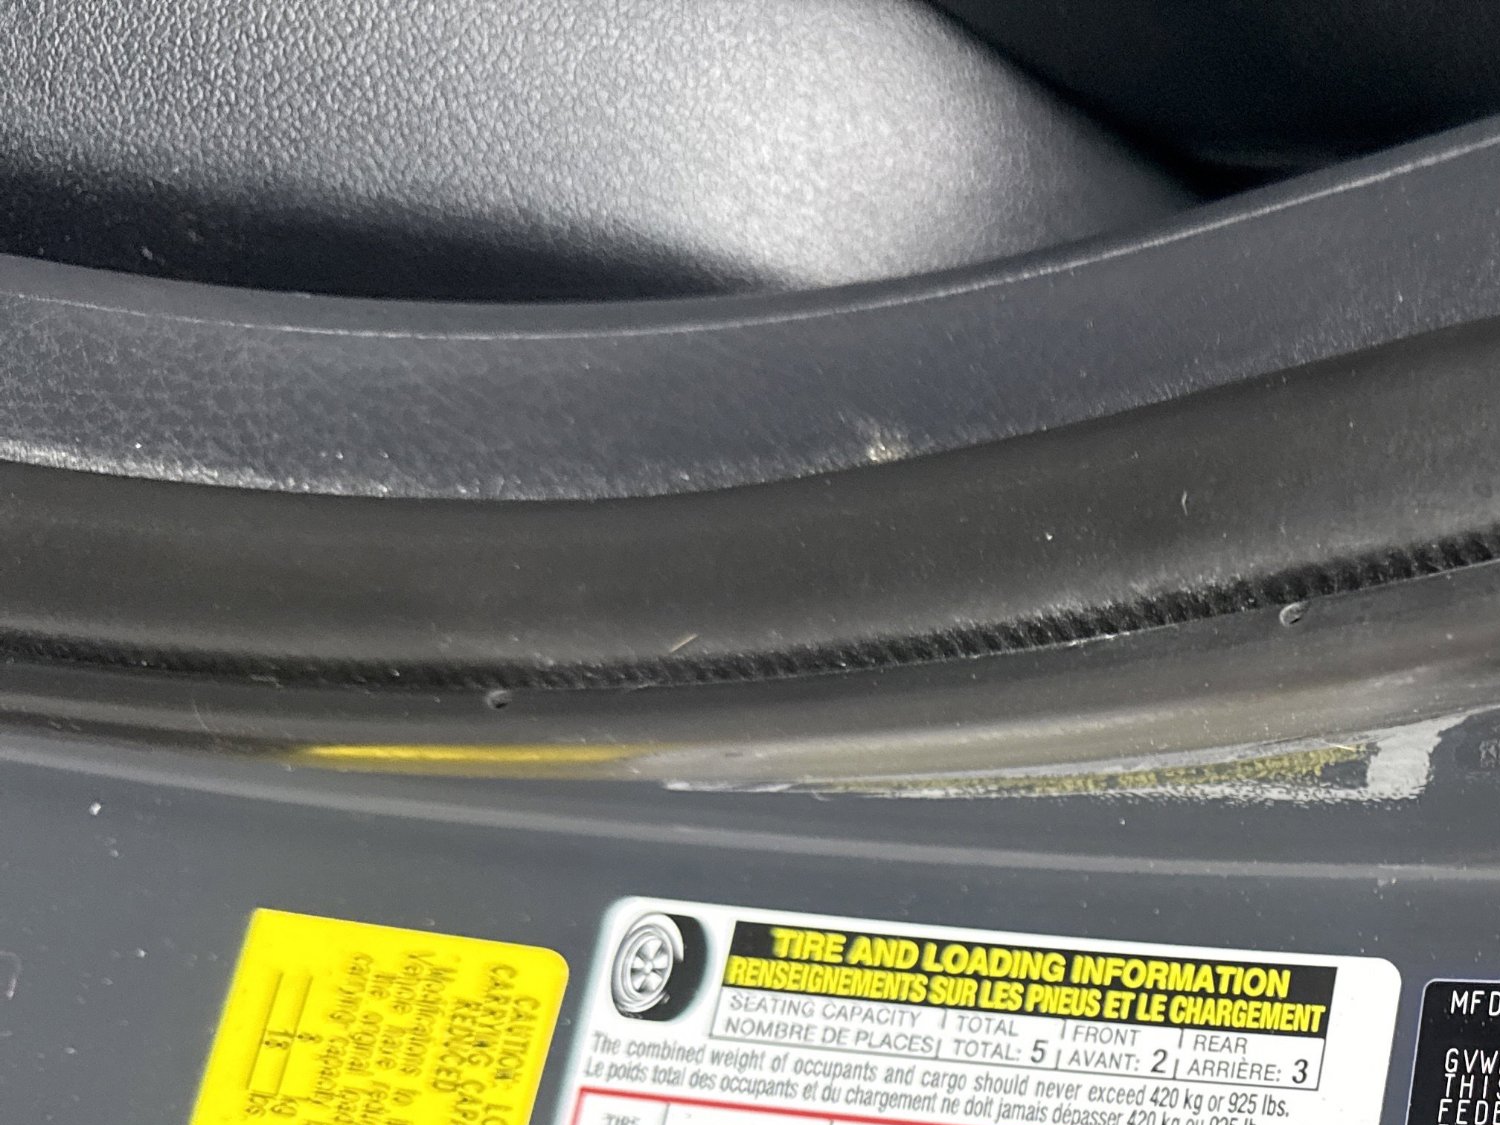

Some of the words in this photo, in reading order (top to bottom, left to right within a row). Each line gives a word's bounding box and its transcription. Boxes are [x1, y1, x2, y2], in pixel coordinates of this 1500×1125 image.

[771, 927, 846, 963] TIRE
[846, 935, 919, 969] AND
[921, 942, 1066, 982] LOADING
[1071, 955, 1290, 998] INFORMATION
[725, 955, 928, 1002] RENSEIGNEMENTS
[927, 975, 978, 1007] SUR
[978, 979, 1025, 1011] LES
[1024, 983, 1102, 1017] PNEUS
[1102, 989, 1136, 1020] ET
[1135, 992, 1168, 1022] LE
[1169, 995, 1326, 1032] CHARGEMENT
[729, 991, 815, 1018] SEATING
[821, 1002, 921, 1027] CAPACITY
[464, 963, 518, 1069] CARRYING
[957, 1014, 1019, 1037] TOTAL
[429, 998, 482, 1095] REDUCED
[724, 1017, 816, 1042] NOMBRE
[820, 1025, 850, 1045] DE
[854, 1029, 934, 1053] PLACES
[953, 1037, 1022, 1061] TOTAL:
[1030, 1038, 1048, 1064] 5
[1071, 1024, 1141, 1047] FRONT
[1192, 1033, 1248, 1055] REAR
[593, 1030, 621, 1055] The
[625, 1039, 706, 1065] combined
[709, 1048, 766, 1071] weight
[770, 1052, 789, 1073] of
[792, 1057, 878, 1088] occupants
[883, 1065, 916, 1085] and
[920, 1069, 967, 1094] cargo
[972, 1071, 1030, 1096] should
[1034, 1080, 1082, 1100] never
[1087, 1084, 1147, 1106] exceed
[1148, 1086, 1180, 1109] 420
[1182, 1088, 1204, 1115] kg
[1207, 1094, 1225, 1112] or
[1227, 1092, 1258, 1115] 925
[1261, 1093, 1289, 1117] lbs.
[1067, 1049, 1140, 1071] AVANT:
[1149, 1048, 1168, 1074] 2
[1186, 1057, 1281, 1082] ARRIÈRE:
[1291, 1058, 1308, 1084] 3
[583, 1056, 605, 1078] Le
[605, 1062, 649, 1083] poids
[650, 1064, 686, 1086] total
[688, 1068, 717, 1090] des
[719, 1074, 799, 1099] occupants
[801, 1080, 819, 1101] et
[822, 1081, 842, 1103] du
[844, 1084, 938, 1113] chargement
[939, 1096, 960, 1114] ne
[963, 1095, 994, 1118] doit
[994, 1097, 1049, 1123] jamais
